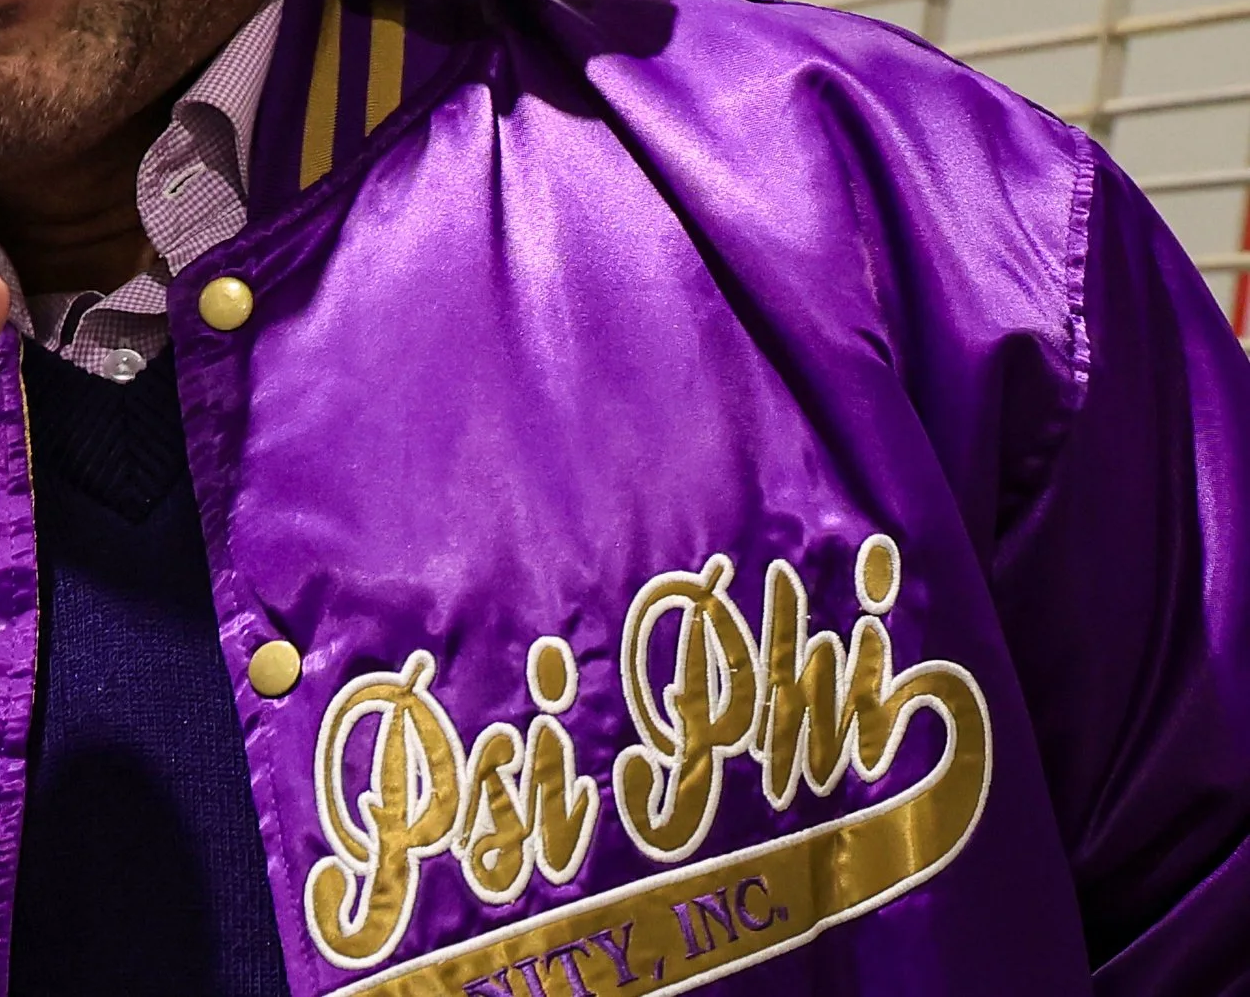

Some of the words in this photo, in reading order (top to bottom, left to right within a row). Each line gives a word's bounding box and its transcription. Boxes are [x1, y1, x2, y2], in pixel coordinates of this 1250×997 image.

[304, 635, 599, 969] Psi
[613, 534, 902, 862] Phi
[671, 876, 788, 959] INC.
